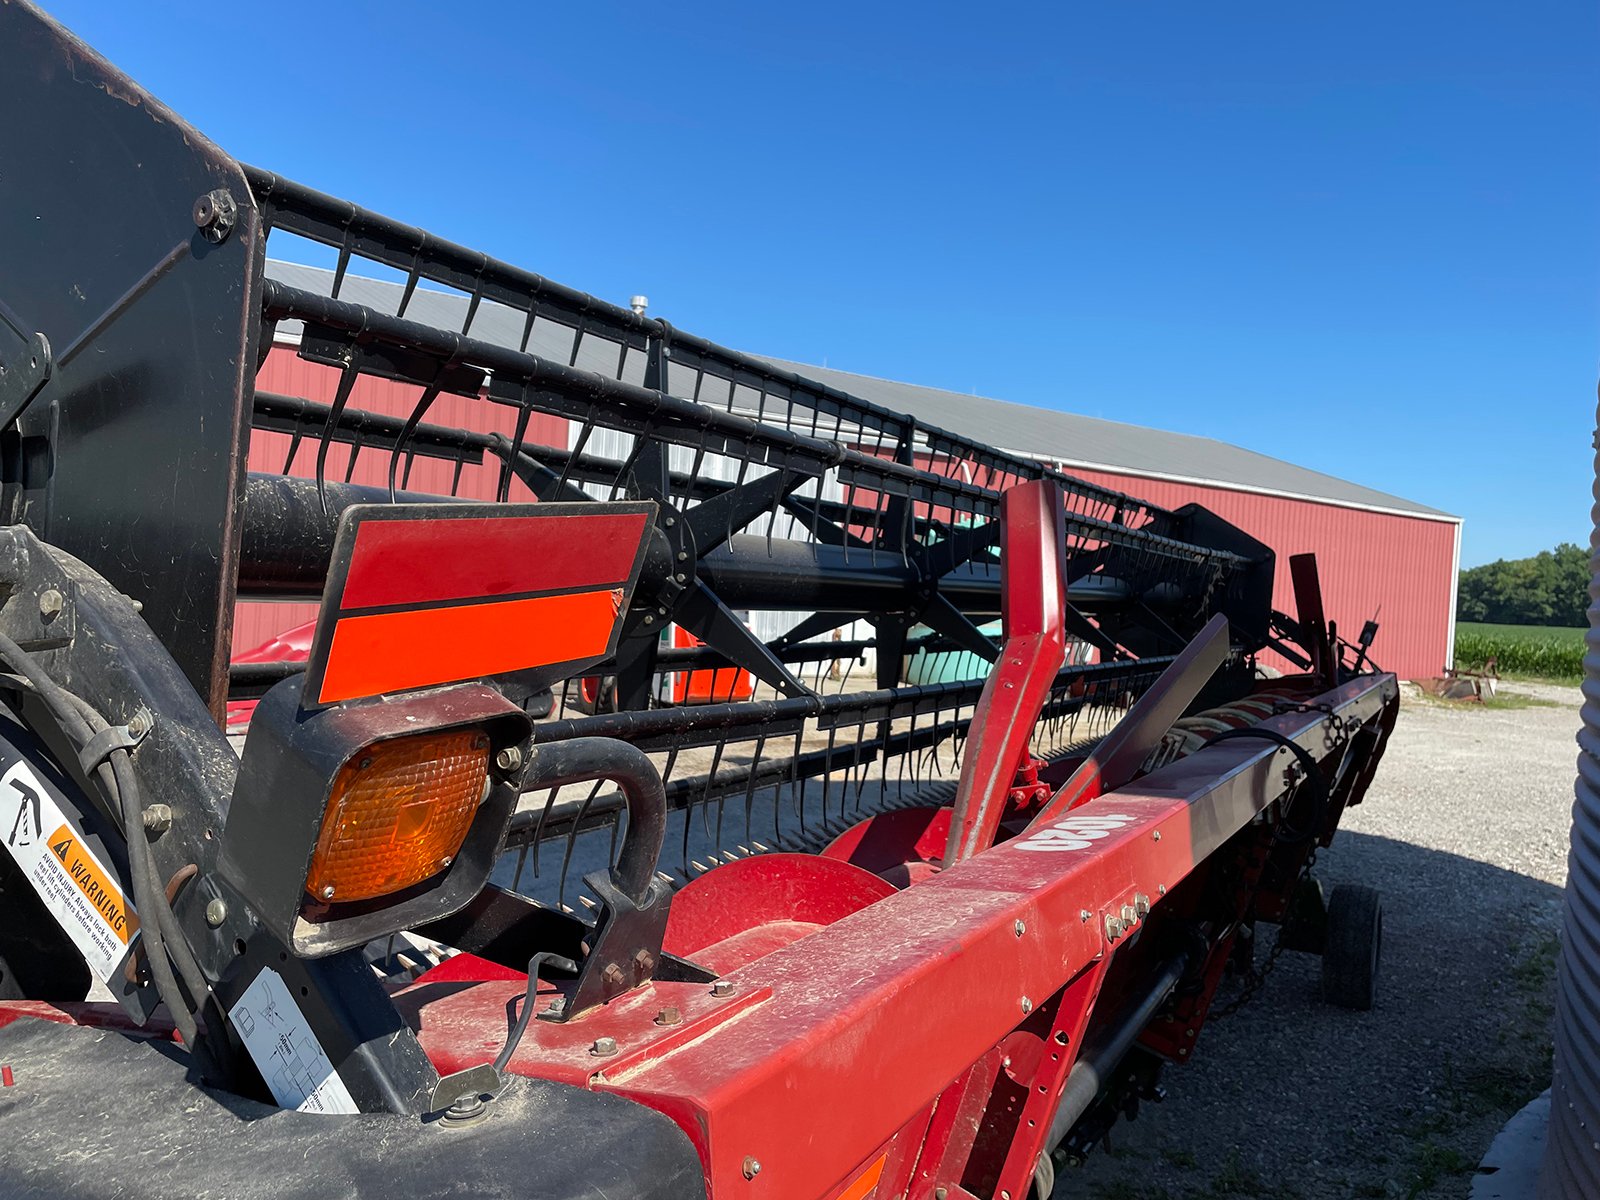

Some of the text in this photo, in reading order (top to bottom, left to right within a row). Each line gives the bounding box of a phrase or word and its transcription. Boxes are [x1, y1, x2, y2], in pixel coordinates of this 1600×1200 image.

[1013, 814, 1137, 851] 1020
[33, 869, 55, 903] under reel.
[38, 861, 48, 875] reel
[46, 872, 55, 885] lift
[53, 884, 76, 913] cylinders
[75, 910, 92, 933] before
[91, 932, 113, 961] working
[42, 853, 117, 952] AVOID INJURY. Always lock both
[70, 859, 126, 931] WARNING
